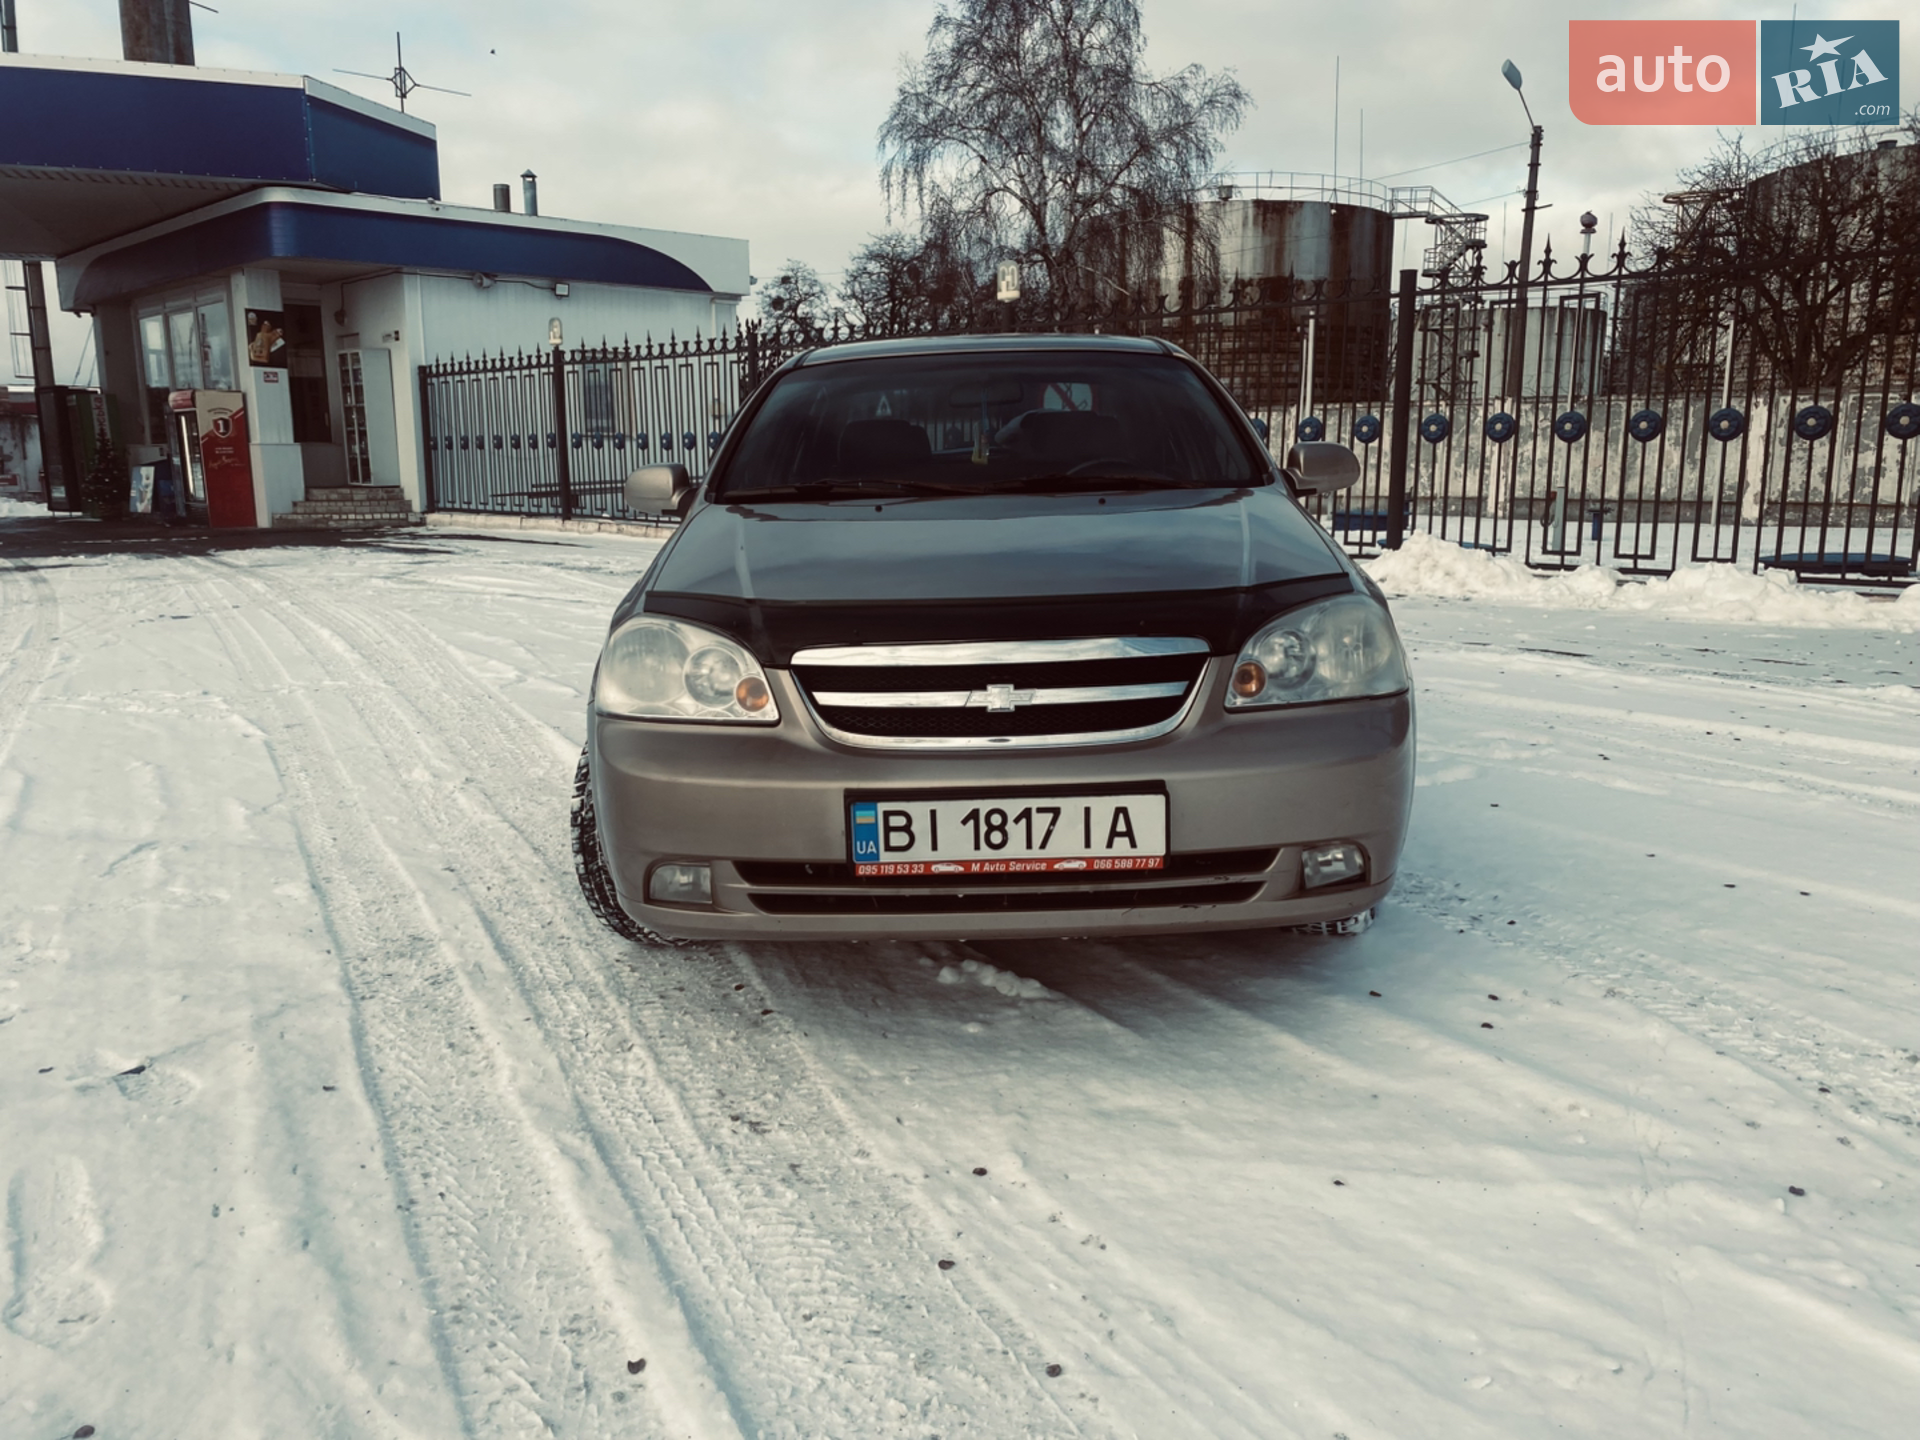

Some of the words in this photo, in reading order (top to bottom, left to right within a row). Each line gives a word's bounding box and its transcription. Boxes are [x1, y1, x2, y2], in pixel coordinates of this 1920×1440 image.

[882, 808, 939, 853] BI
[960, 806, 1062, 852] 1817
[1083, 805, 1139, 850] IA
[856, 840, 877, 855] UA
[858, 864, 878, 875] 095
[880, 864, 895, 875] 119
[896, 863, 910, 874] 53
[911, 863, 925, 874] 33
[971, 862, 980, 872] M
[983, 862, 1006, 872] Avto
[1008, 860, 1048, 871] Service
[1093, 859, 1113, 869] 066
[1135, 858, 1147, 869] 77
[1147, 857, 1161, 868] 97
